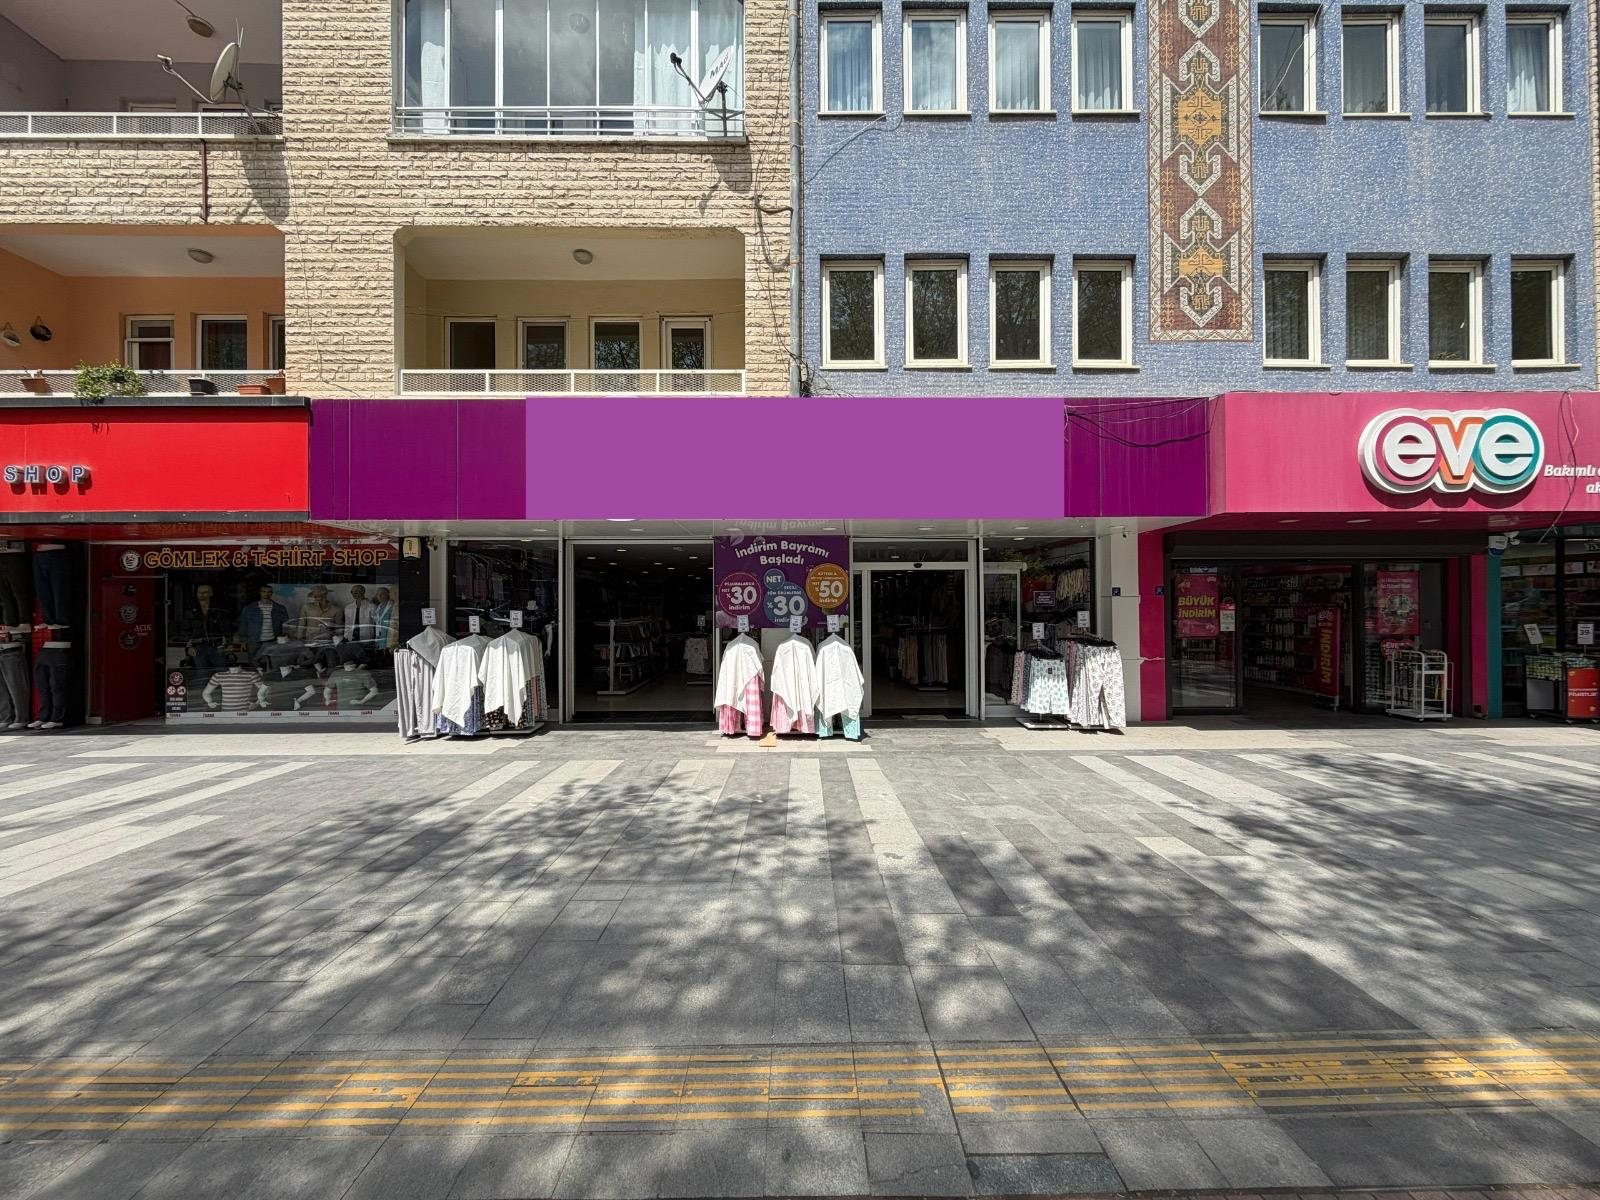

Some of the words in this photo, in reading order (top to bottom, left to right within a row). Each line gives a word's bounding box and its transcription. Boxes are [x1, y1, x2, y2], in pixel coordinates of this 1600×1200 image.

[1375, 414, 1540, 485] eve
[4, 465, 87, 483] SHOP
[781, 541, 830, 558] Bayramı
[144, 547, 230, 568] GÖMLEK
[232, 551, 248, 567] &
[253, 546, 324, 567] T-SHİRT
[333, 549, 389, 566] SHOP
[760, 554, 804, 566] Başladı
[766, 575, 782, 583] NET
[1178, 595, 1216, 606] BÜYÜK
[1177, 608, 1217, 618] İNDİRİM
